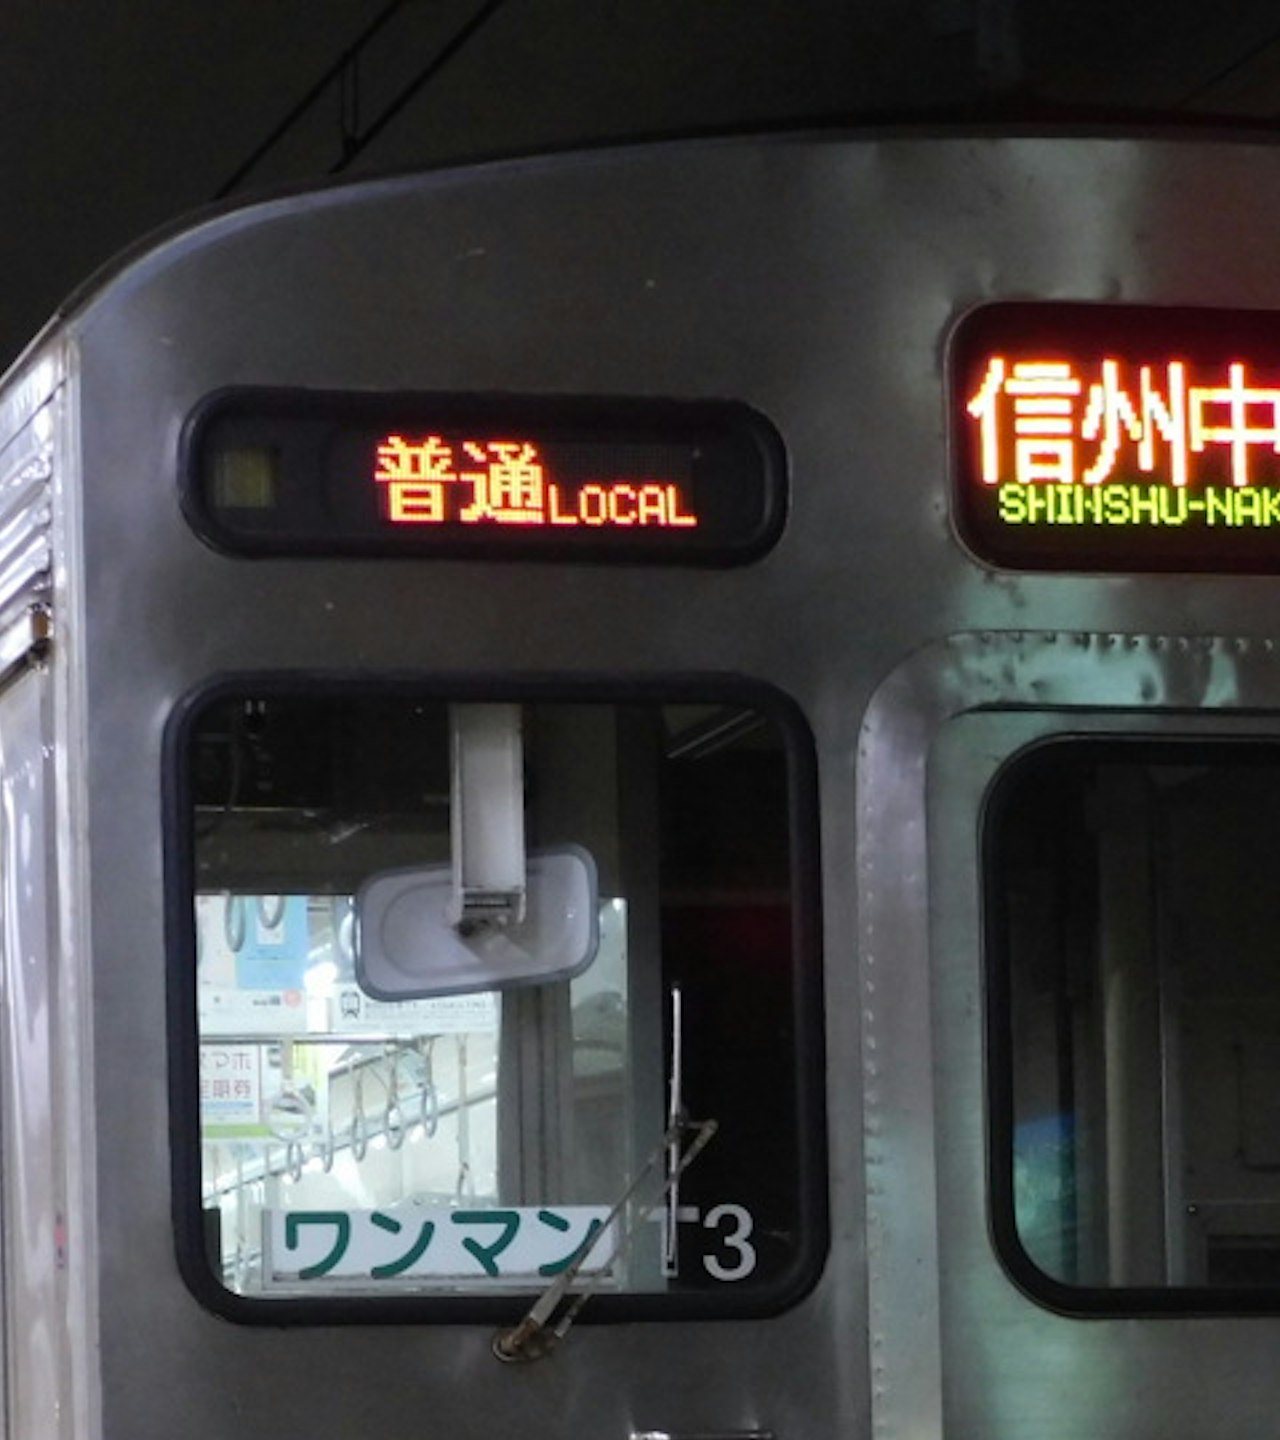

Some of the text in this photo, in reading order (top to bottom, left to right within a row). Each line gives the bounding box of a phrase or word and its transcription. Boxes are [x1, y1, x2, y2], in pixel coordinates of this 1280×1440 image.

[375, 436, 697, 527] 普通 LOCAL
[285, 1209, 604, 1279] ワンマン
